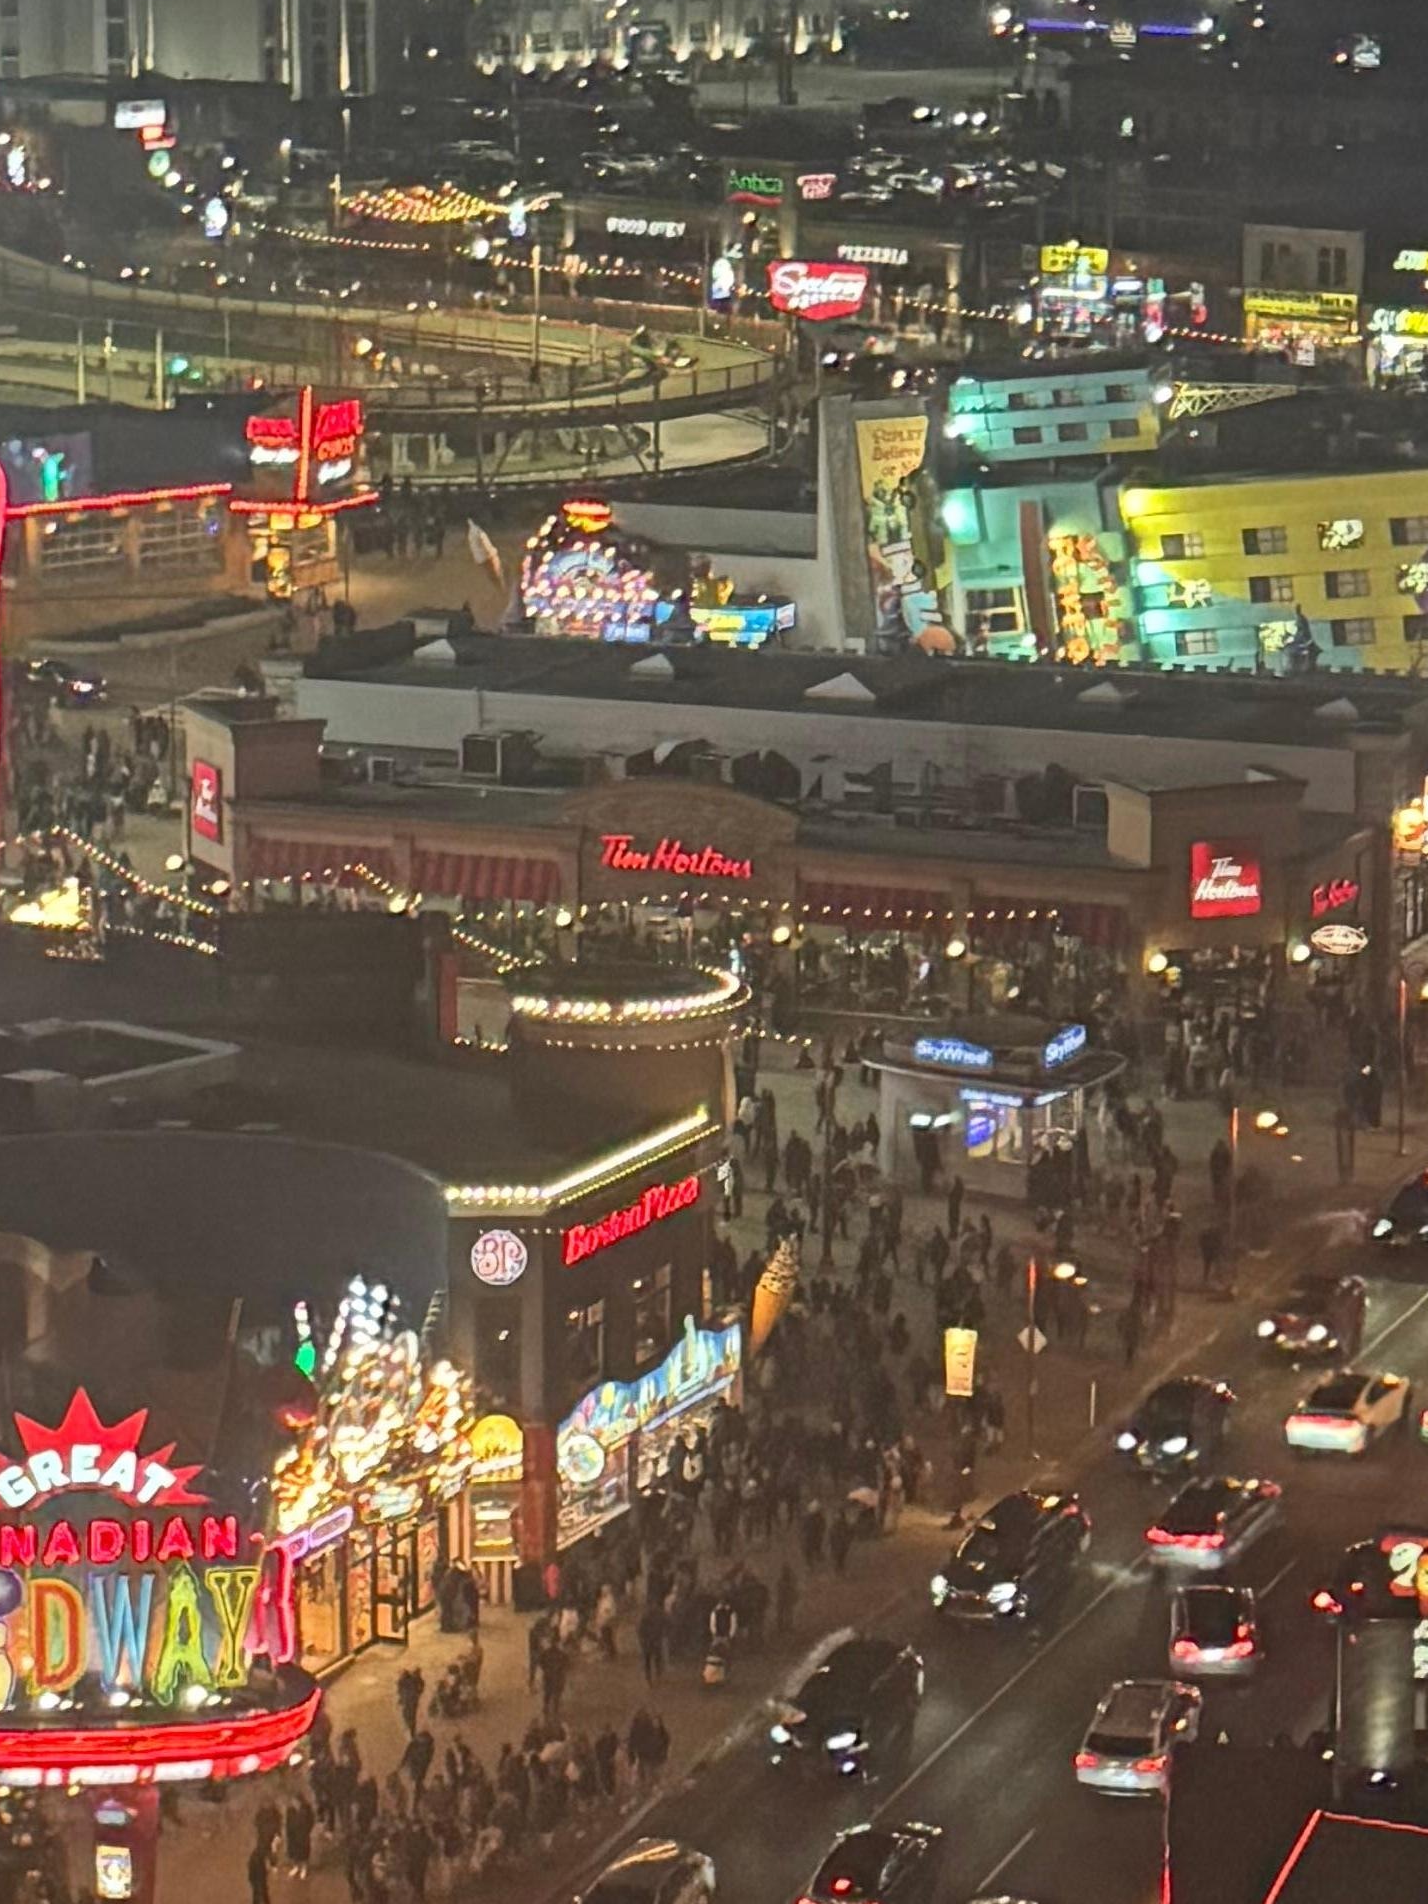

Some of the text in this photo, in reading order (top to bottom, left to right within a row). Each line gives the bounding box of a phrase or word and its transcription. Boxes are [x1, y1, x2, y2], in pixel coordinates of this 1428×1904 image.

[729, 170, 784, 193] Antica
[600, 834, 752, 880] Tim Hortons
[1211, 856, 1244, 879] Tim
[1194, 878, 1259, 901] Hortons
[917, 1039, 993, 1065] SkyWheel
[565, 1175, 700, 1266] Boston Pizza
